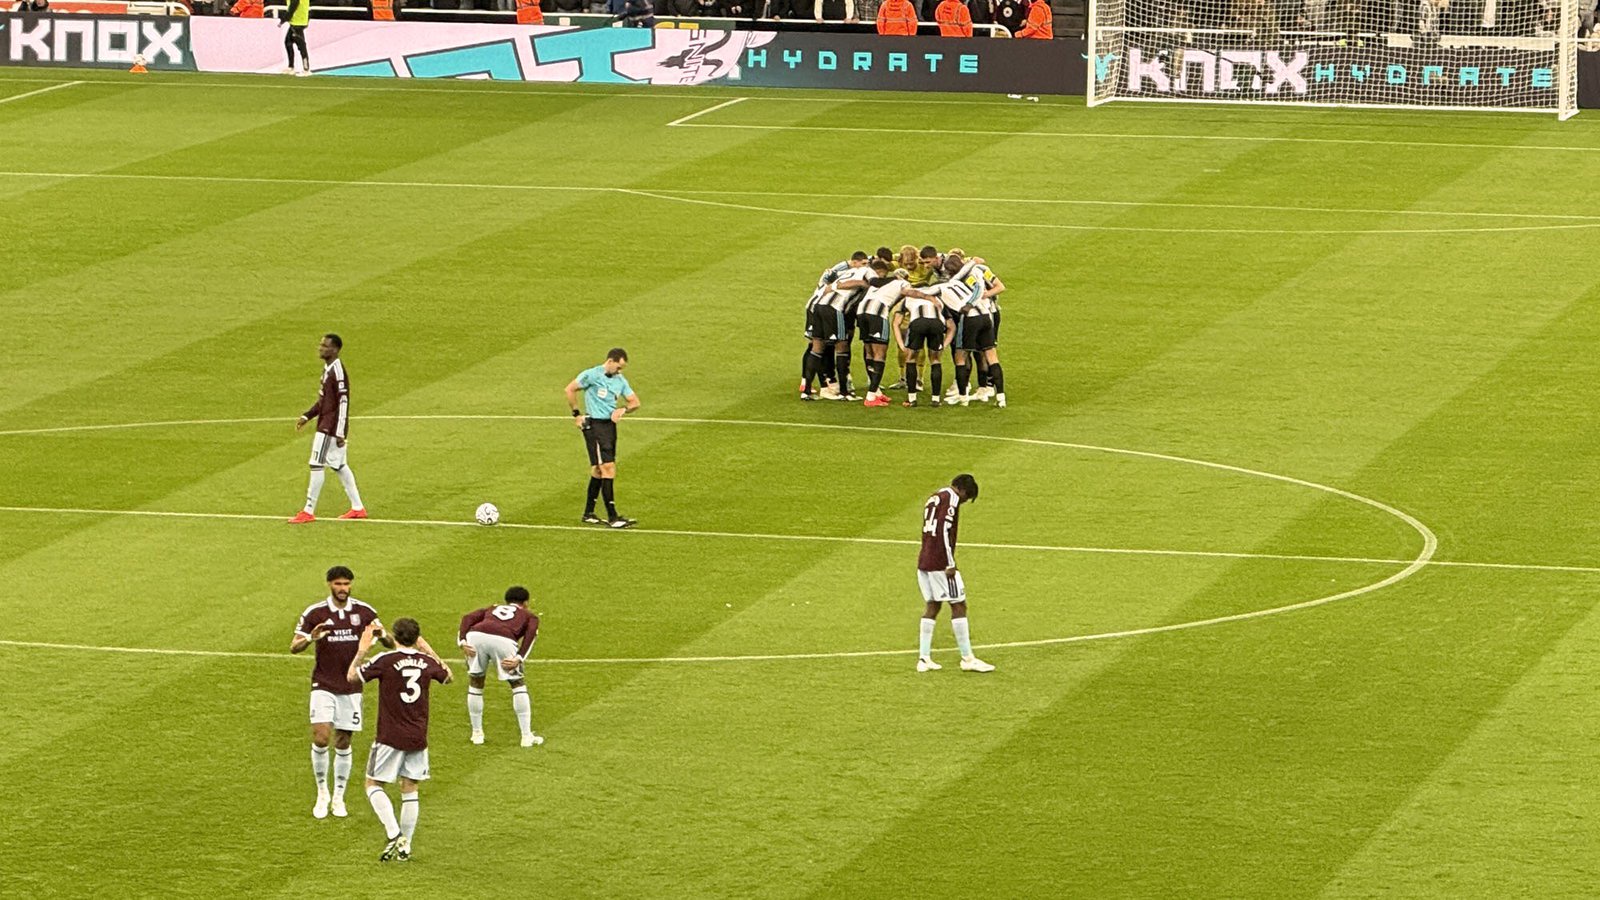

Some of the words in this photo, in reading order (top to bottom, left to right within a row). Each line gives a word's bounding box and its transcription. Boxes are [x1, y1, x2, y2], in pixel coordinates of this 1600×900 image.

[10, 18, 182, 64] KNOX
[748, 49, 979, 74] HYDRATE
[492, 605, 517, 621] 8
[400, 668, 421, 703] 3
[352, 711, 361, 725] 5
